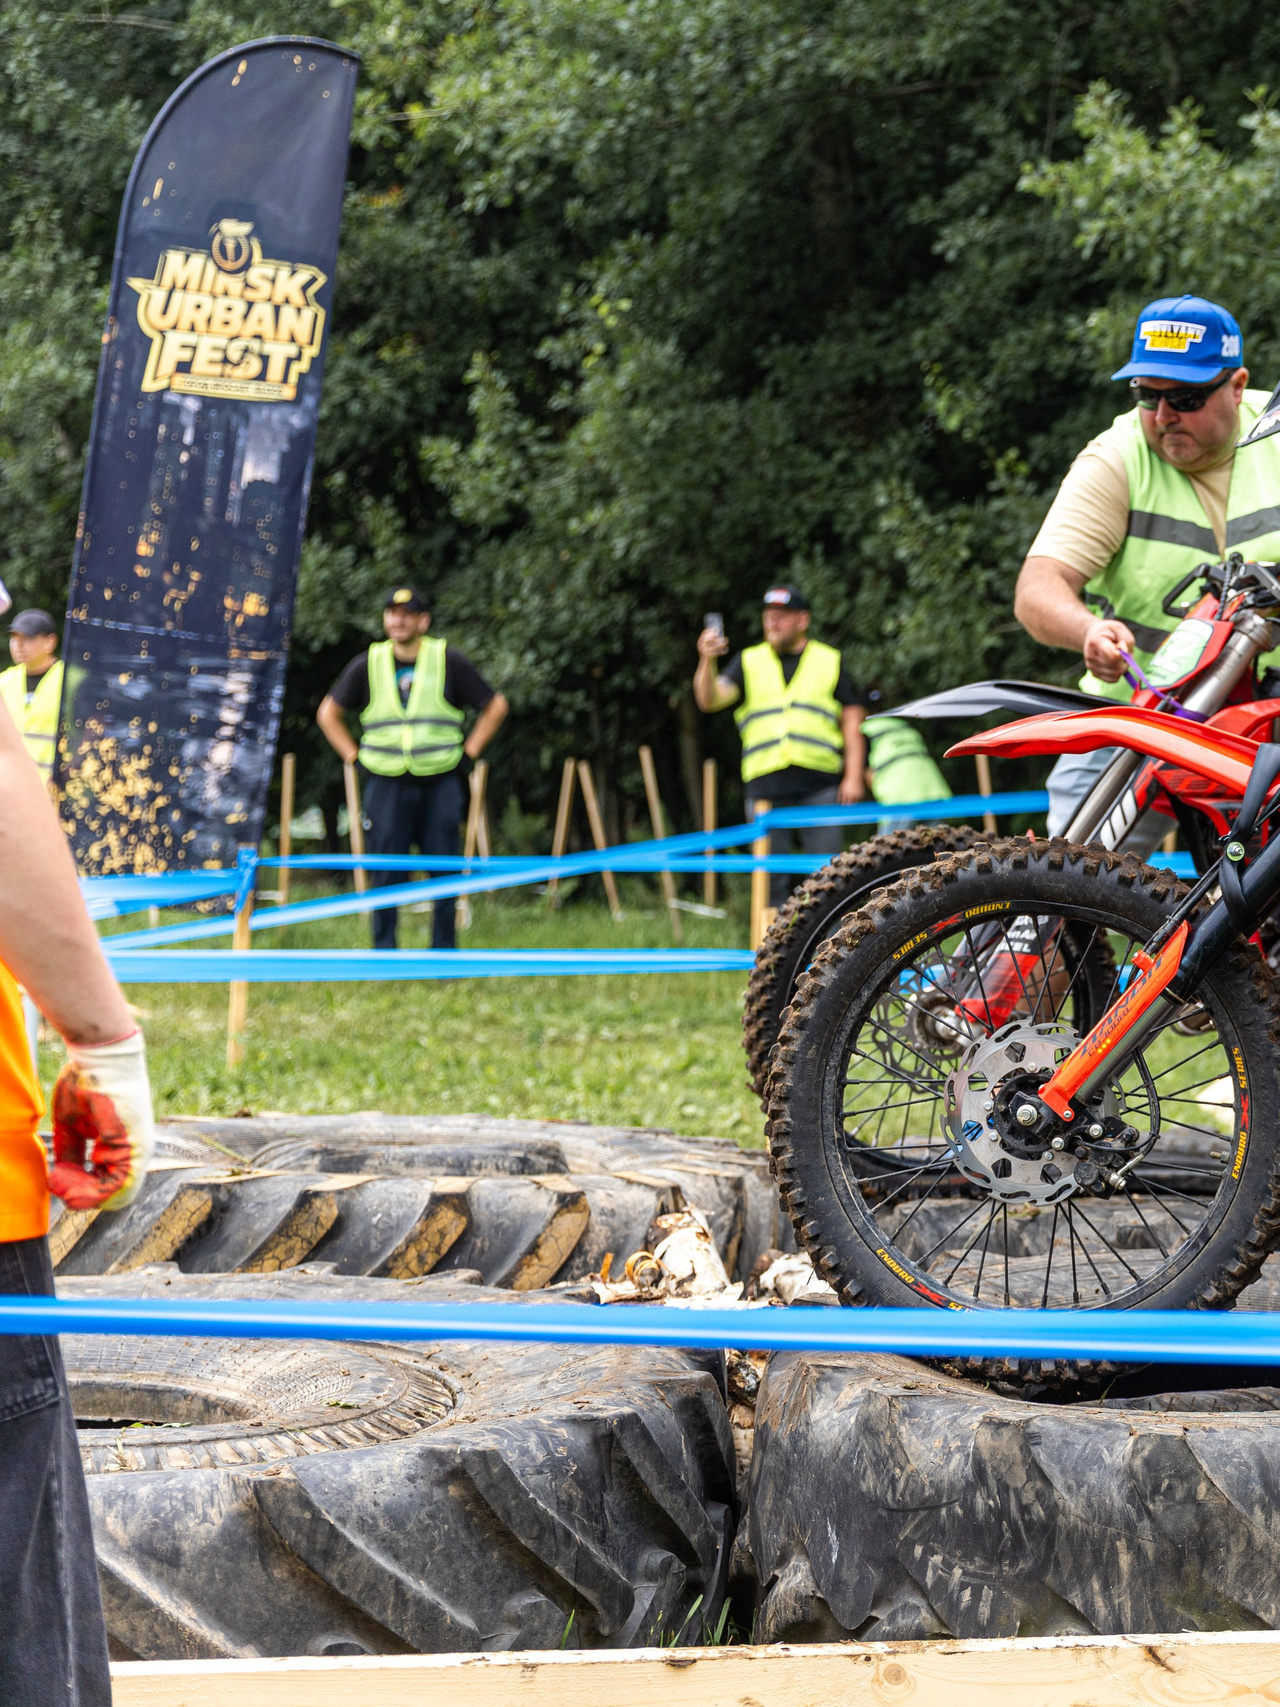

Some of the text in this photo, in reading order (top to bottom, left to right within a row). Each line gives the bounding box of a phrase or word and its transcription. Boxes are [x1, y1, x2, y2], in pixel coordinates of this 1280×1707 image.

[160, 251, 314, 308] MINSK
[147, 289, 316, 346] URBAN
[155, 330, 300, 383] FEST
[893, 902, 1011, 960] ENDURO X SERIES
[1231, 1046, 1250, 1180] ENDURO X SERIES
[876, 1248, 948, 1306] ENDURO X
